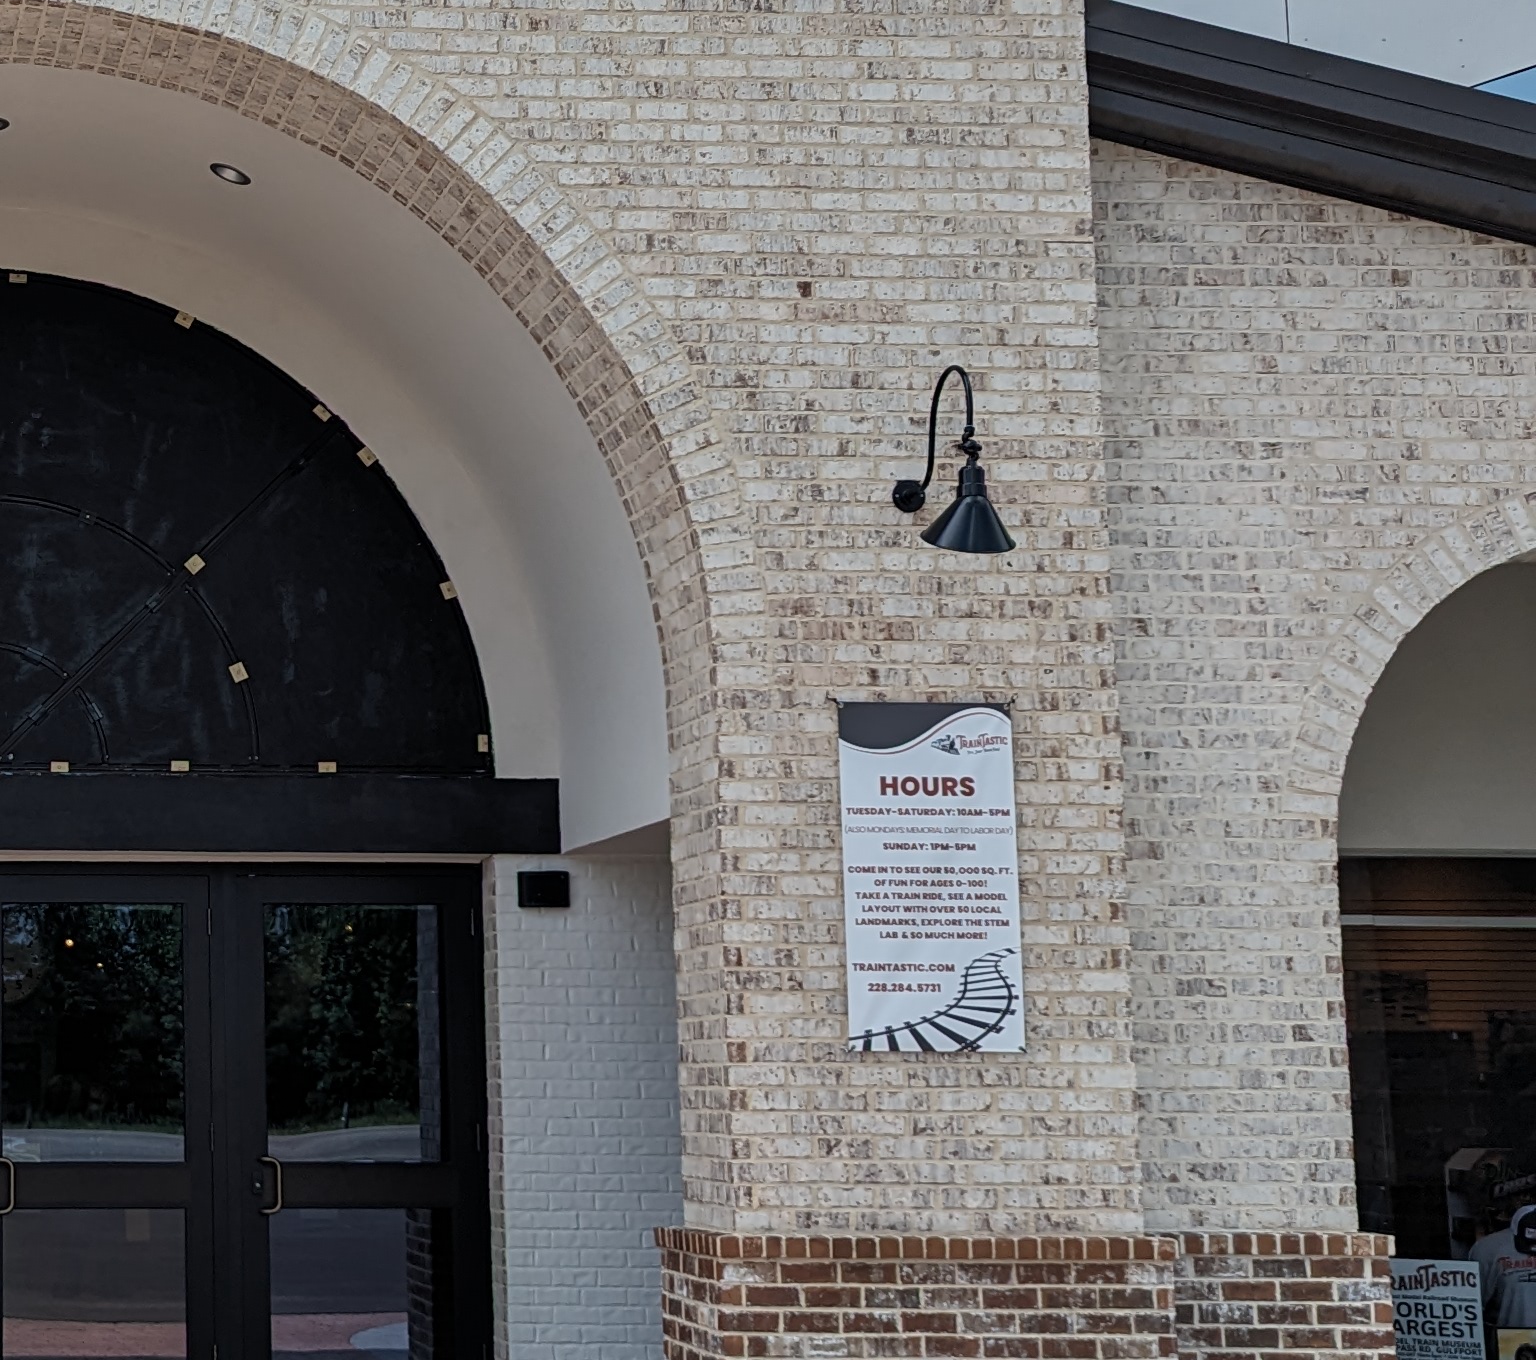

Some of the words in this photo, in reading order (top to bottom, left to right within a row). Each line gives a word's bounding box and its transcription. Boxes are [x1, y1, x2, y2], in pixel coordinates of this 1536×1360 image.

[879, 776, 975, 797] HOURS
[883, 842, 929, 851] SUNDAY:
[848, 866, 876, 874] COME
[889, 866, 902, 874] TO
[905, 866, 920, 874] SEE
[922, 866, 942, 874] OUR
[981, 867, 997, 876] SQ.
[999, 867, 1014, 875] FT.
[874, 879, 886, 887] OF
[889, 879, 908, 887] FUN
[909, 879, 929, 887] FOR
[930, 879, 954, 887] AGES
[956, 880, 987, 888] 0-100!
[855, 892, 881, 900] TAKE
[883, 892, 890, 900] A
[891, 892, 921, 900] TRAIN
[922, 892, 946, 901] RIDE,
[948, 892, 964, 901] SEE
[974, 893, 1008, 901] MODEL
[862, 905, 901, 913] LAYOUT
[903, 905, 928, 913] WITH
[957, 906, 969, 914] 50
[971, 906, 1002, 914] LOCAL
[855, 918, 919, 927] LANDMARKS,
[921, 918, 964, 926] EXPLORE
[965, 919, 983, 927] THE
[984, 919, 1010, 927] STEM
[880, 931, 898, 939] LAB
[902, 931, 909, 939] &
[910, 931, 923, 939] SO
[925, 931, 955, 939] MUCH
[957, 931, 988, 940] MORE!
[852, 963, 956, 972] TRAINTASTIC.COM
[867, 983, 941, 992] 228.284.5731
[1390, 1263, 1478, 1292] RAINTASTIC
[1392, 1301, 1478, 1320] ORLD'S
[1392, 1319, 1478, 1338] ARGEST
[1413, 1338, 1439, 1346] TRAIN
[1442, 1340, 1481, 1349] MUSEUM
[1436, 1347, 1482, 1356] GULFPORT
